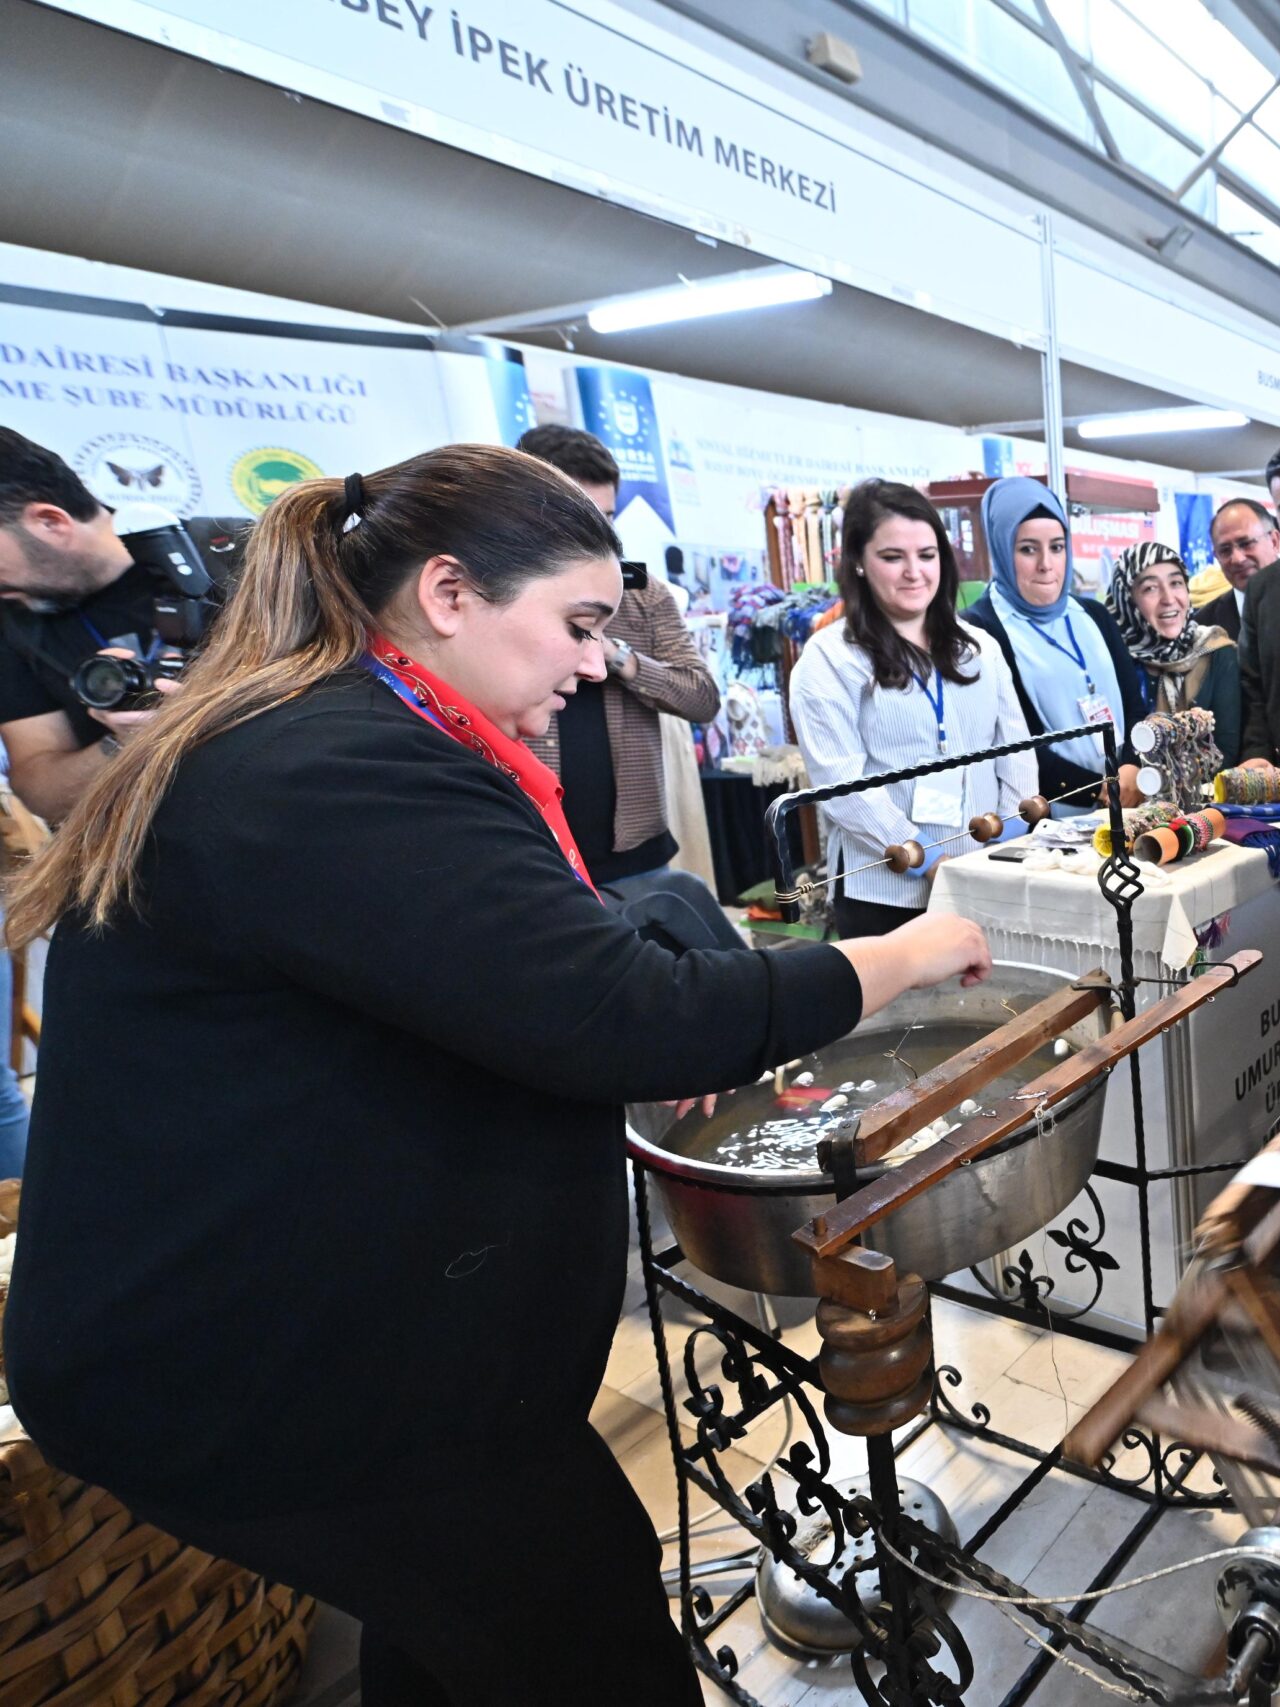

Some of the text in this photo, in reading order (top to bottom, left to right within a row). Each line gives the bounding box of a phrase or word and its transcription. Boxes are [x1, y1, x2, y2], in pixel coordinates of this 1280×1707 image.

[449, 10, 554, 94] İPEK
[563, 62, 704, 158] ÜRETİM
[713, 135, 837, 214] MERKEZİ
